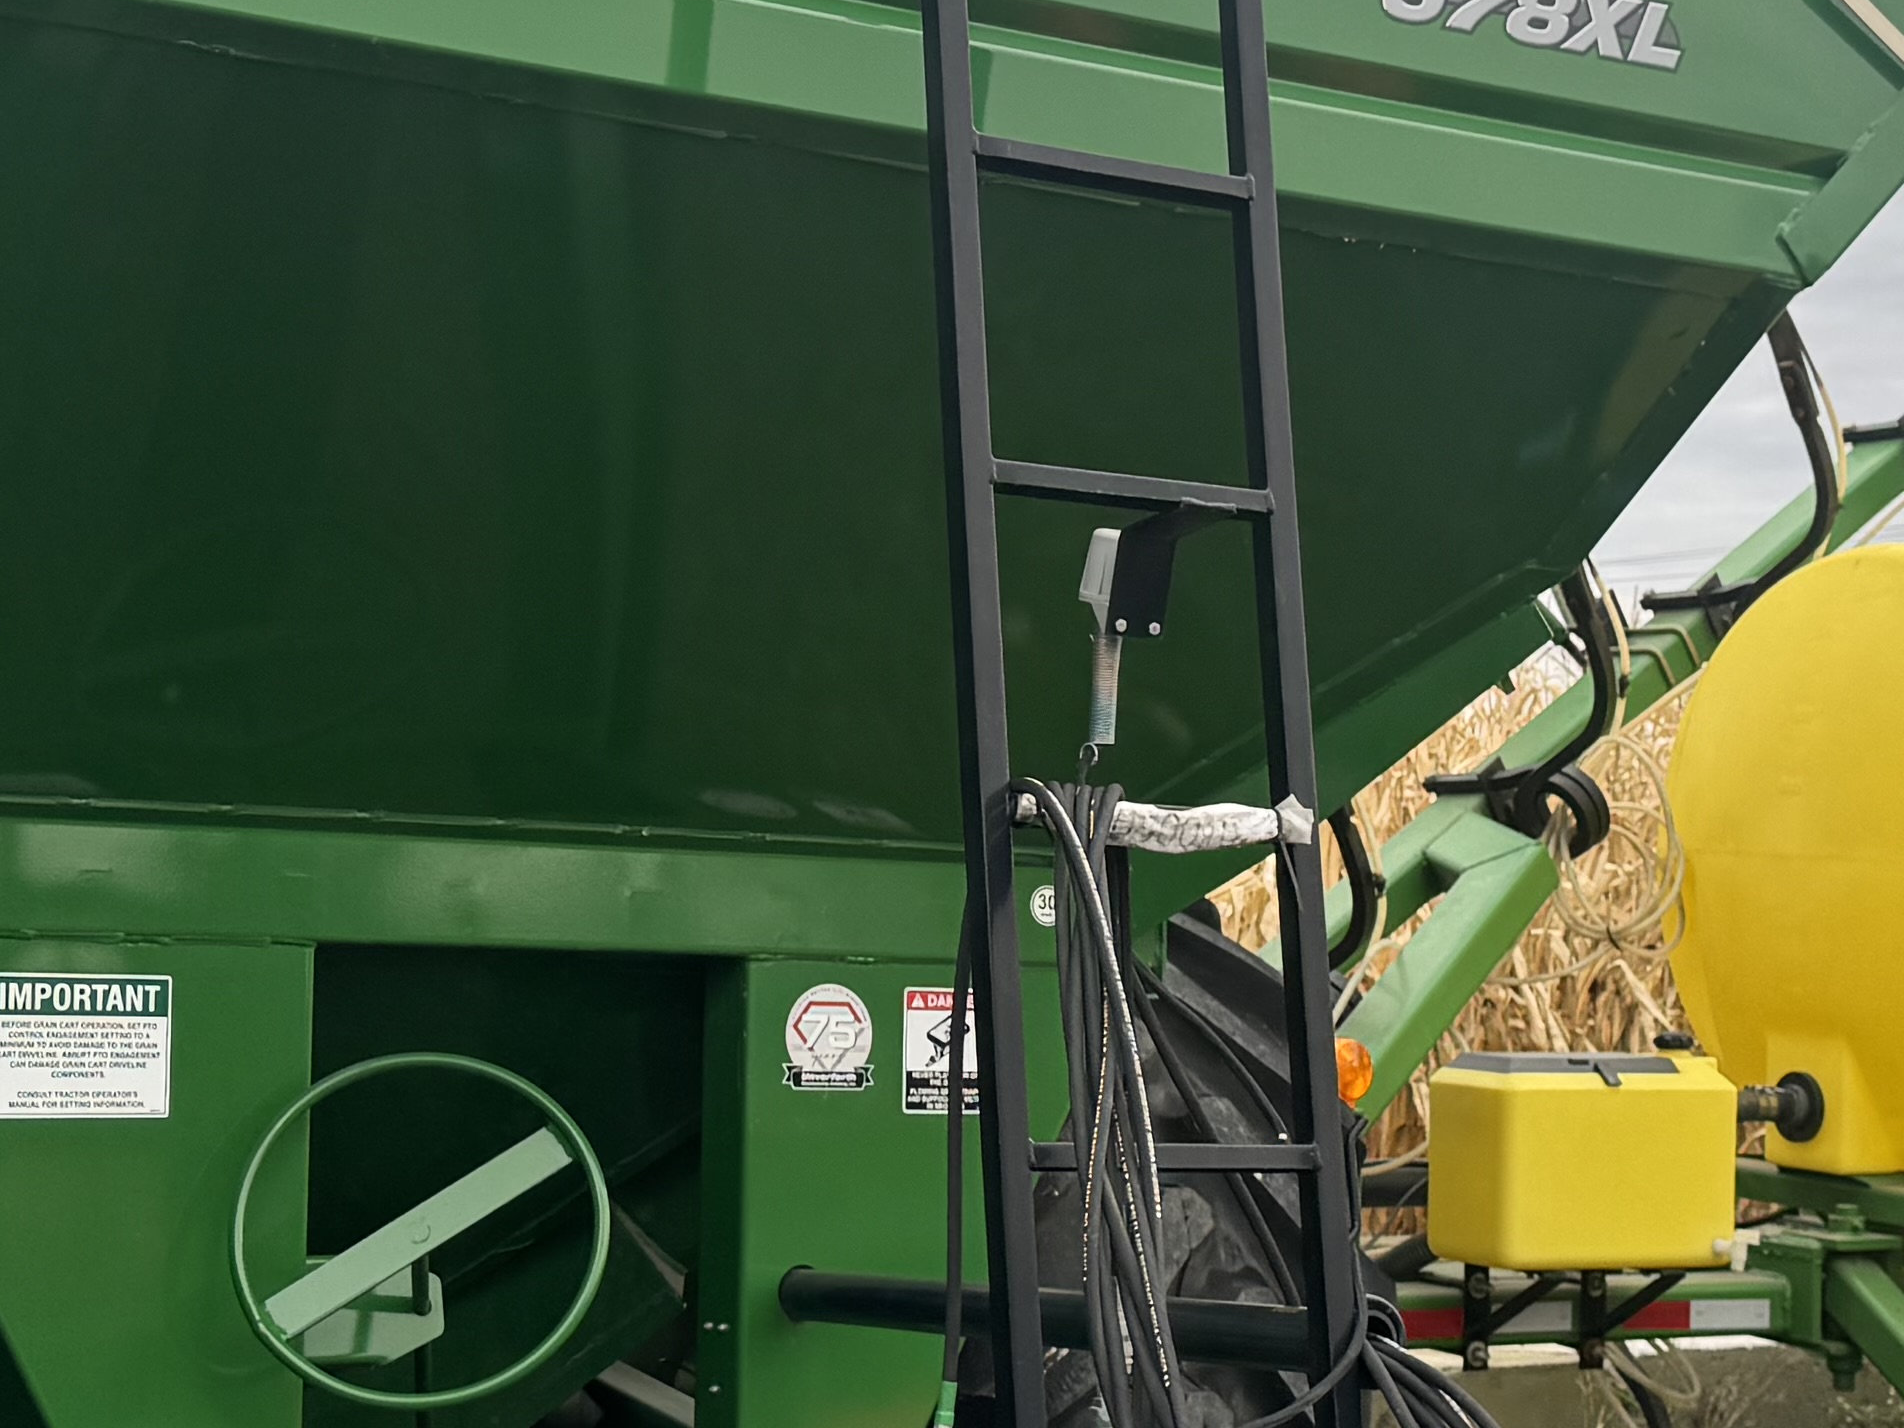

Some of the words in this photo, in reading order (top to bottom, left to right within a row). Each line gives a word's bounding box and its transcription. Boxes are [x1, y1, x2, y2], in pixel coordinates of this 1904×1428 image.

[0, 982, 160, 1012] IMPORTANT
[927, 995, 974, 1008] DANE
[34, 1021, 57, 1029] GRAIN
[802, 1014, 857, 1051] 75
